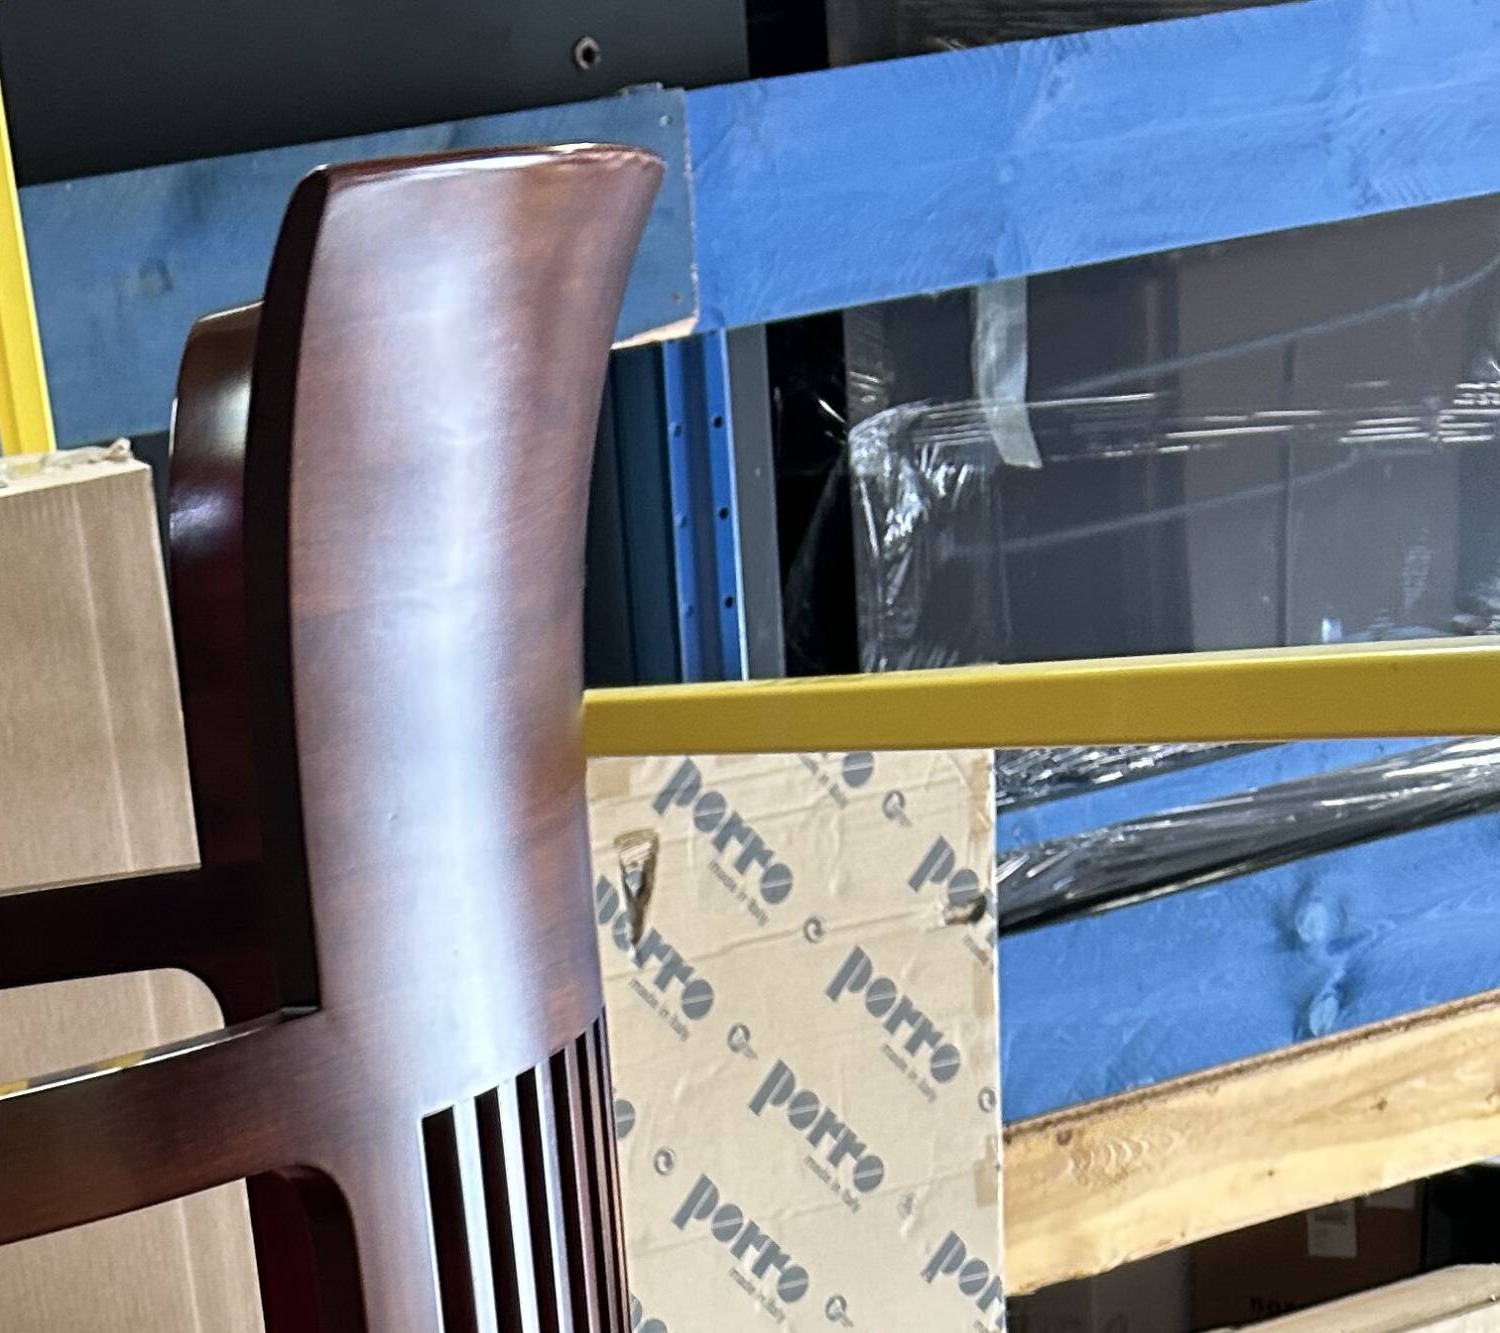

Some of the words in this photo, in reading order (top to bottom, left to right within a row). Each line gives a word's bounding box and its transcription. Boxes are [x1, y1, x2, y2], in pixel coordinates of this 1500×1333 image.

[652, 757, 794, 904] porro
[826, 944, 962, 1084] porro
[748, 1057, 886, 1194] porro
[671, 1173, 810, 1304] porro
